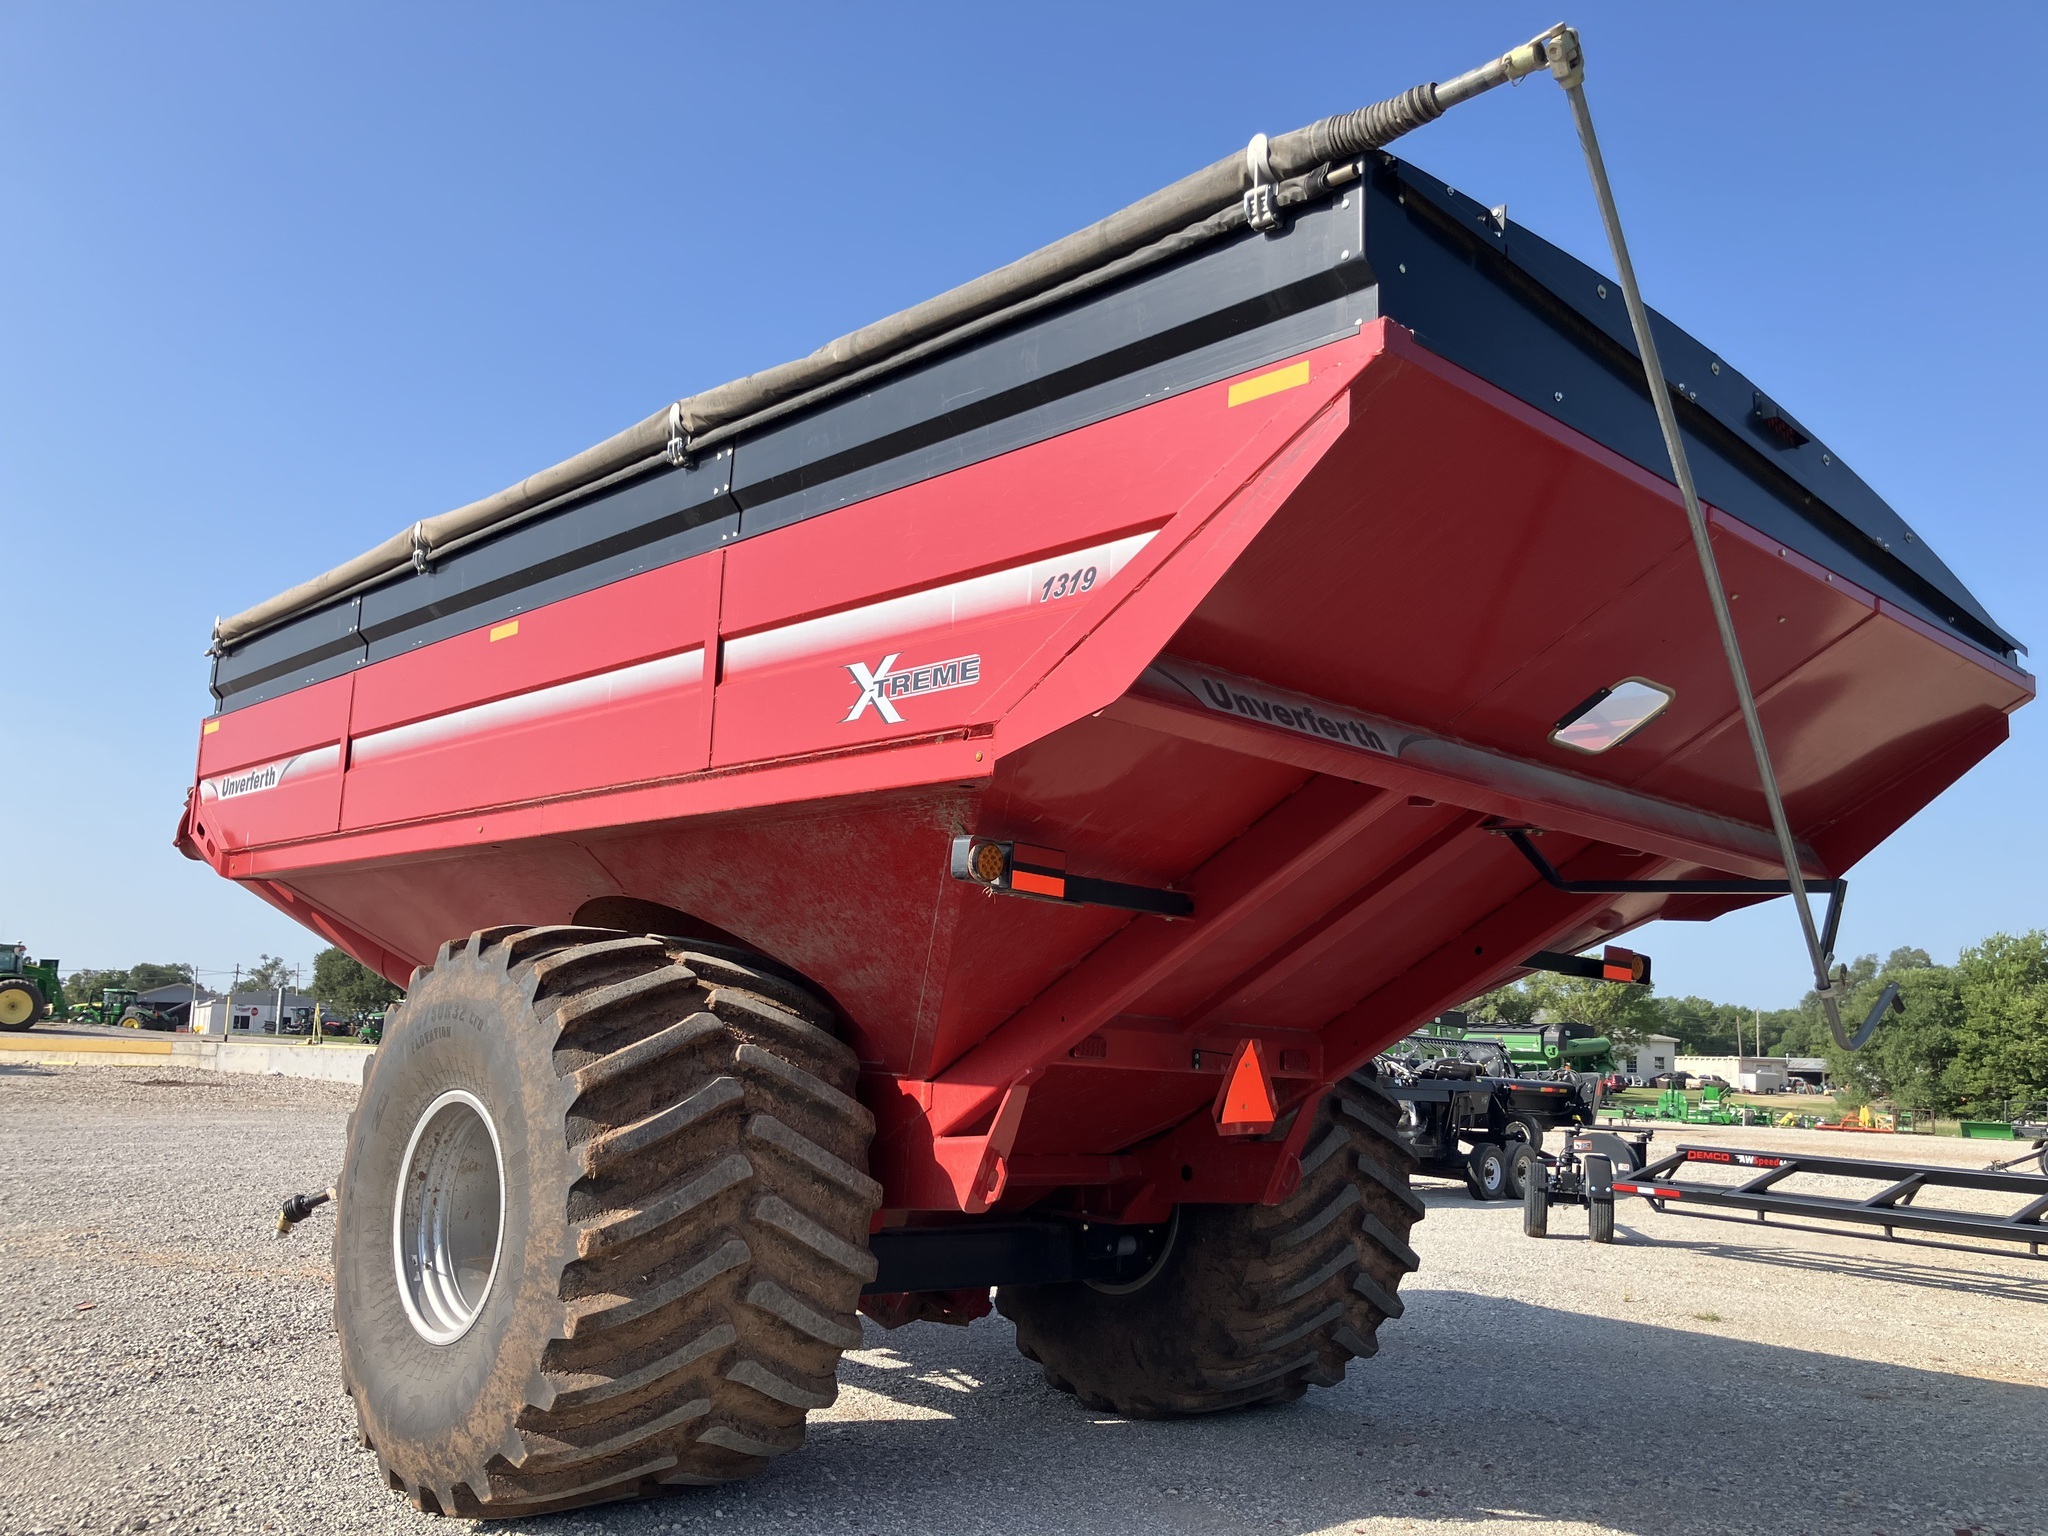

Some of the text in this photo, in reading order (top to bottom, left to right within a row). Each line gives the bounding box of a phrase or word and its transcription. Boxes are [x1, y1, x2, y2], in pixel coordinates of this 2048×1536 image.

[1040, 565, 1098, 603] 1319
[837, 652, 981, 724] XTREME
[1201, 678, 1388, 752] Unverferth
[221, 765, 277, 797] Unverferth
[1687, 1149, 1731, 1162] DEMCO
